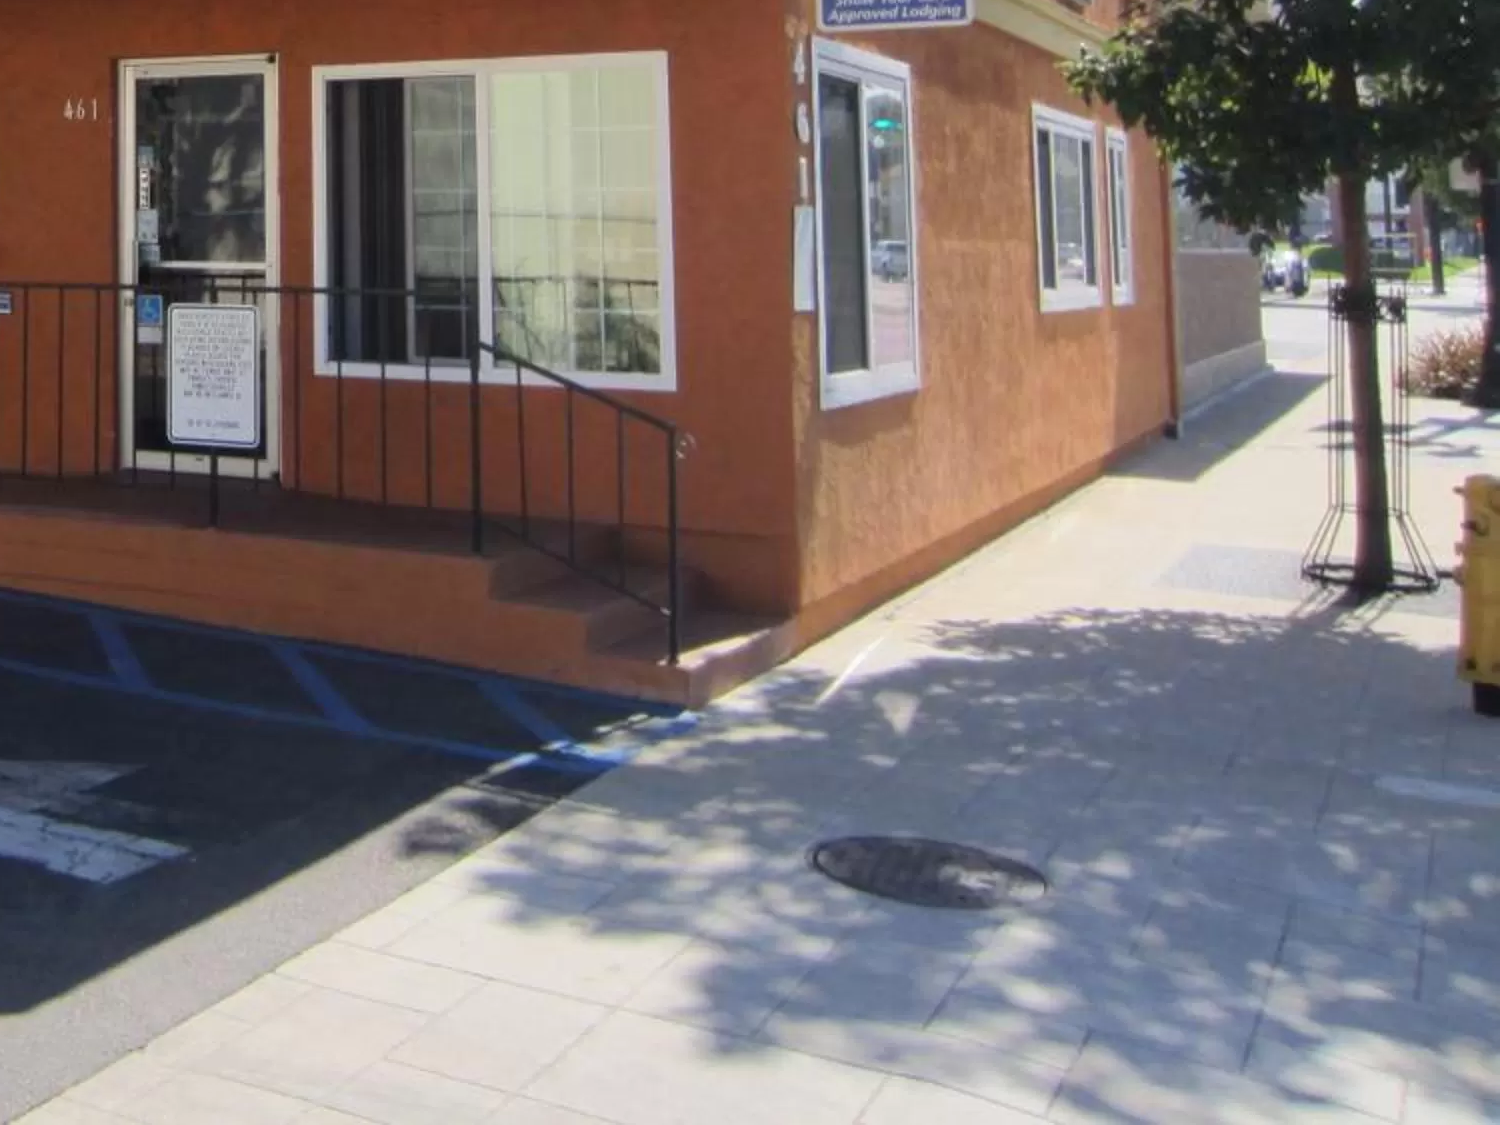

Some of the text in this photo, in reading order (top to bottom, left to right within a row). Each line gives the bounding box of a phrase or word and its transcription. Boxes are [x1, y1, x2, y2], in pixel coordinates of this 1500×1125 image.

[828, 4, 962, 23] Approved Lodging
[63, 98, 97, 120] 461
